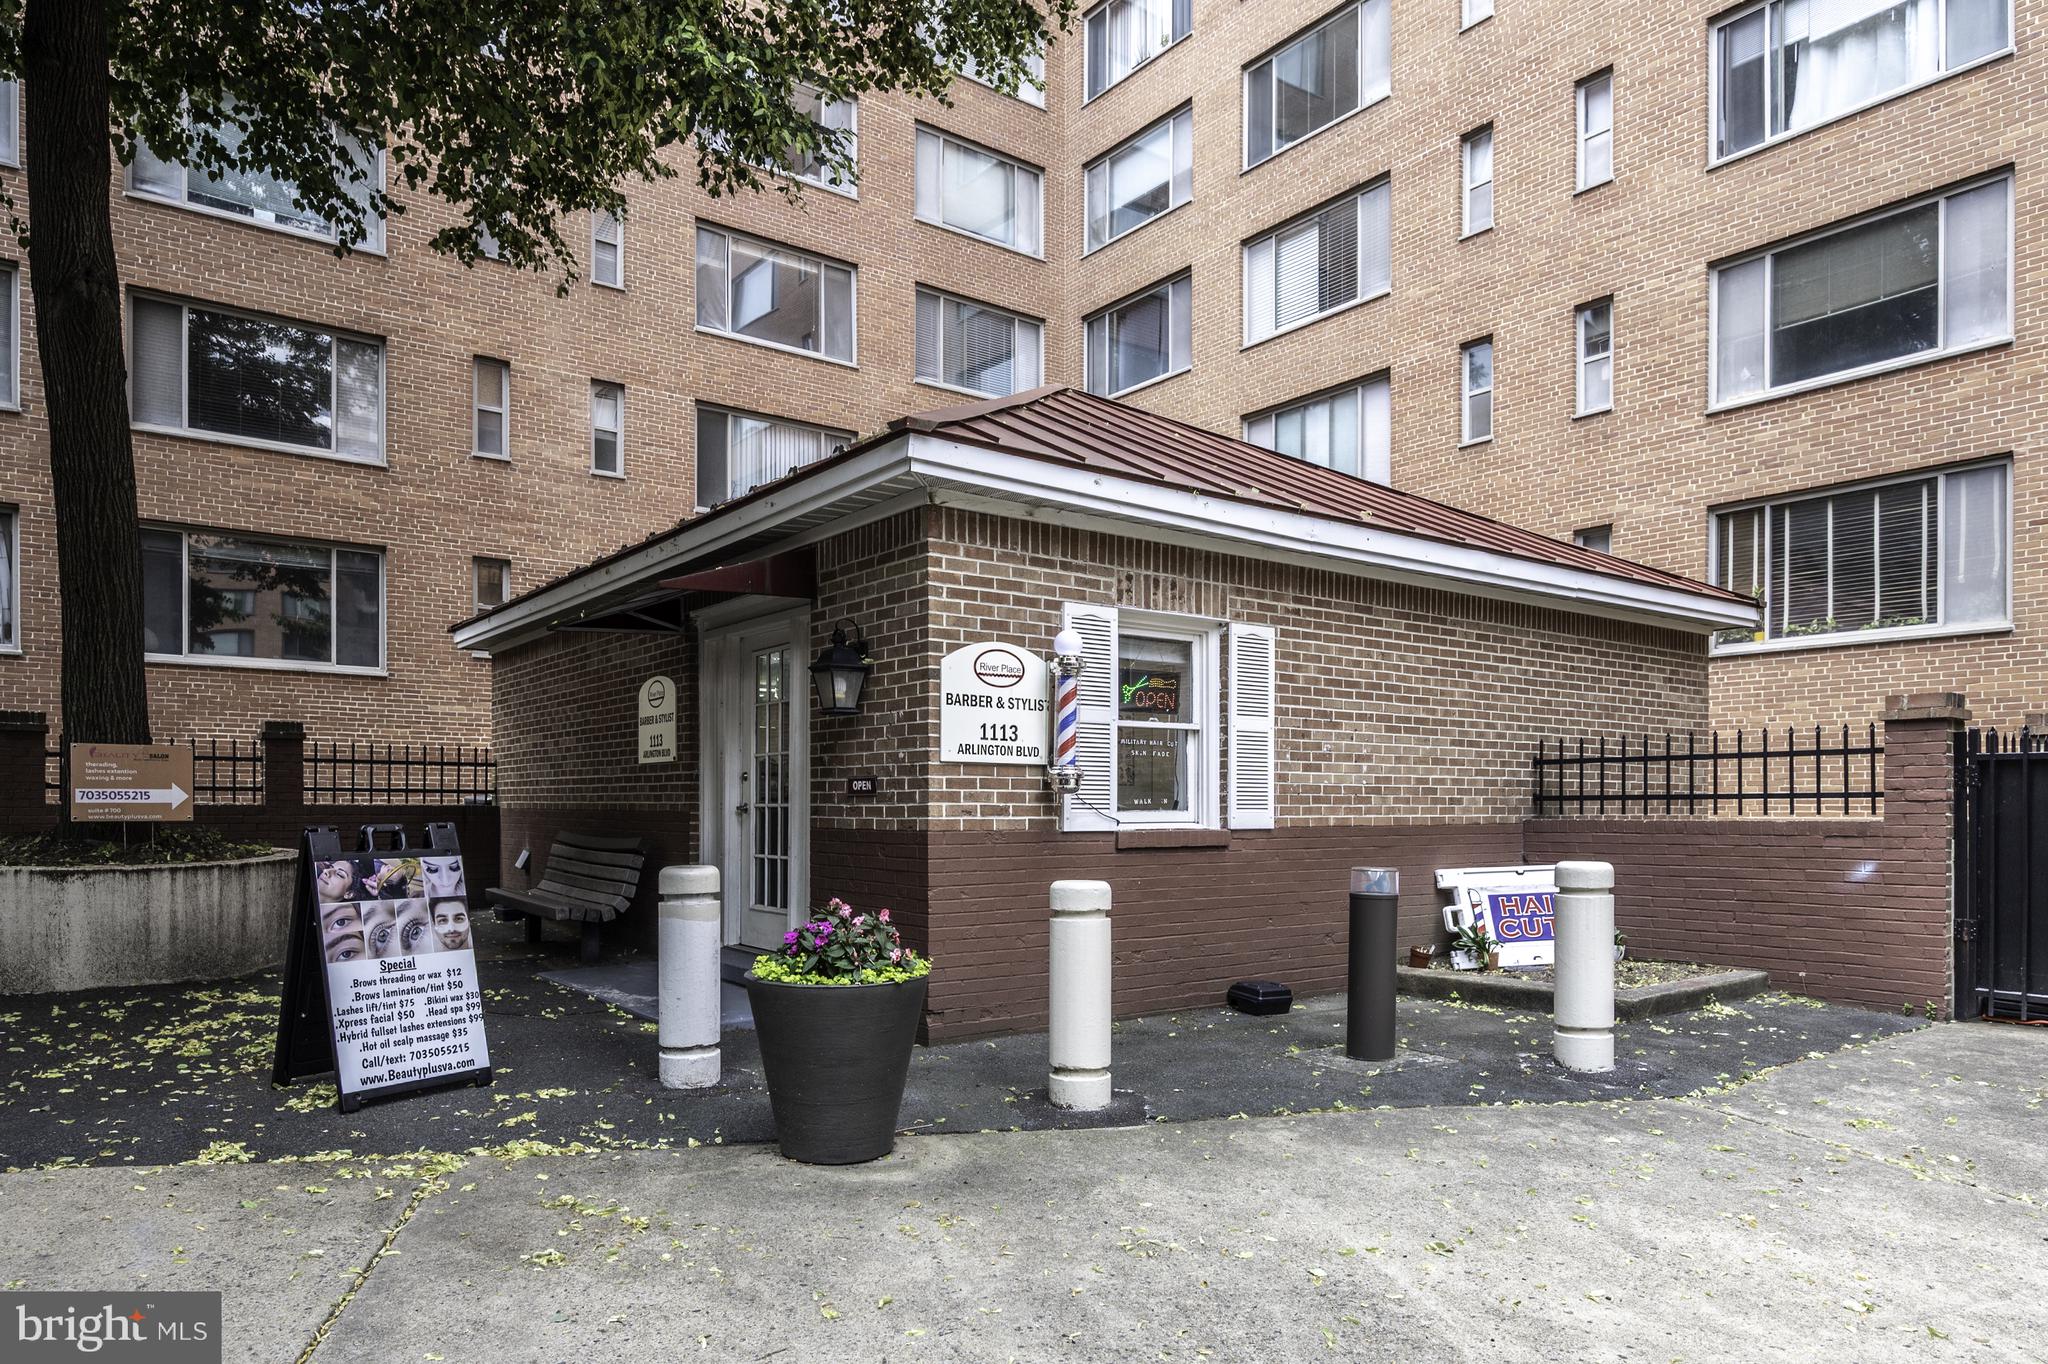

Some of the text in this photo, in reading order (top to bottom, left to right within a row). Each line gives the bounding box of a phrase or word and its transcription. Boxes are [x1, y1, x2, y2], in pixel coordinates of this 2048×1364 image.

[979, 662, 1022, 674] River Place
[946, 692, 993, 709] BARBER
[996, 696, 1005, 709] &
[1135, 691, 1175, 709] OPEN
[650, 733, 663, 747] 1113
[980, 723, 1018, 742] 1113
[957, 743, 1040, 758] ARLINGTON BLVD
[852, 781, 872, 790] OPEN
[78, 791, 151, 800] 7035055215
[1498, 895, 1554, 916] HAI
[379, 957, 416, 972] Special
[379, 974, 416, 985] threading
[417, 973, 426, 981] or
[427, 971, 442, 979] wax
[446, 968, 462, 978] $12
[382, 982, 445, 998] lamination/tint
[447, 979, 464, 990] $50
[366, 1000, 397, 1014] lift/tint
[399, 999, 415, 1009] $75
[450, 994, 464, 1002] wax
[465, 991, 480, 1001] $30
[370, 1012, 394, 1024] facial
[397, 1009, 415, 1021] $50
[450, 1006, 463, 1016] spa
[465, 1002, 481, 1012] $99
[370, 1024, 398, 1037] fullset
[400, 1020, 425, 1033] lashes
[426, 1016, 467, 1030] extensions
[379, 1038, 391, 1049] oil
[392, 1034, 414, 1048] scalp
[416, 1031, 450, 1044] massage
[452, 1028, 469, 1039] $35
[362, 1042, 470, 1070] Call/text: 7035055215
[360, 1057, 476, 1086] www.Beautyplusva.com
